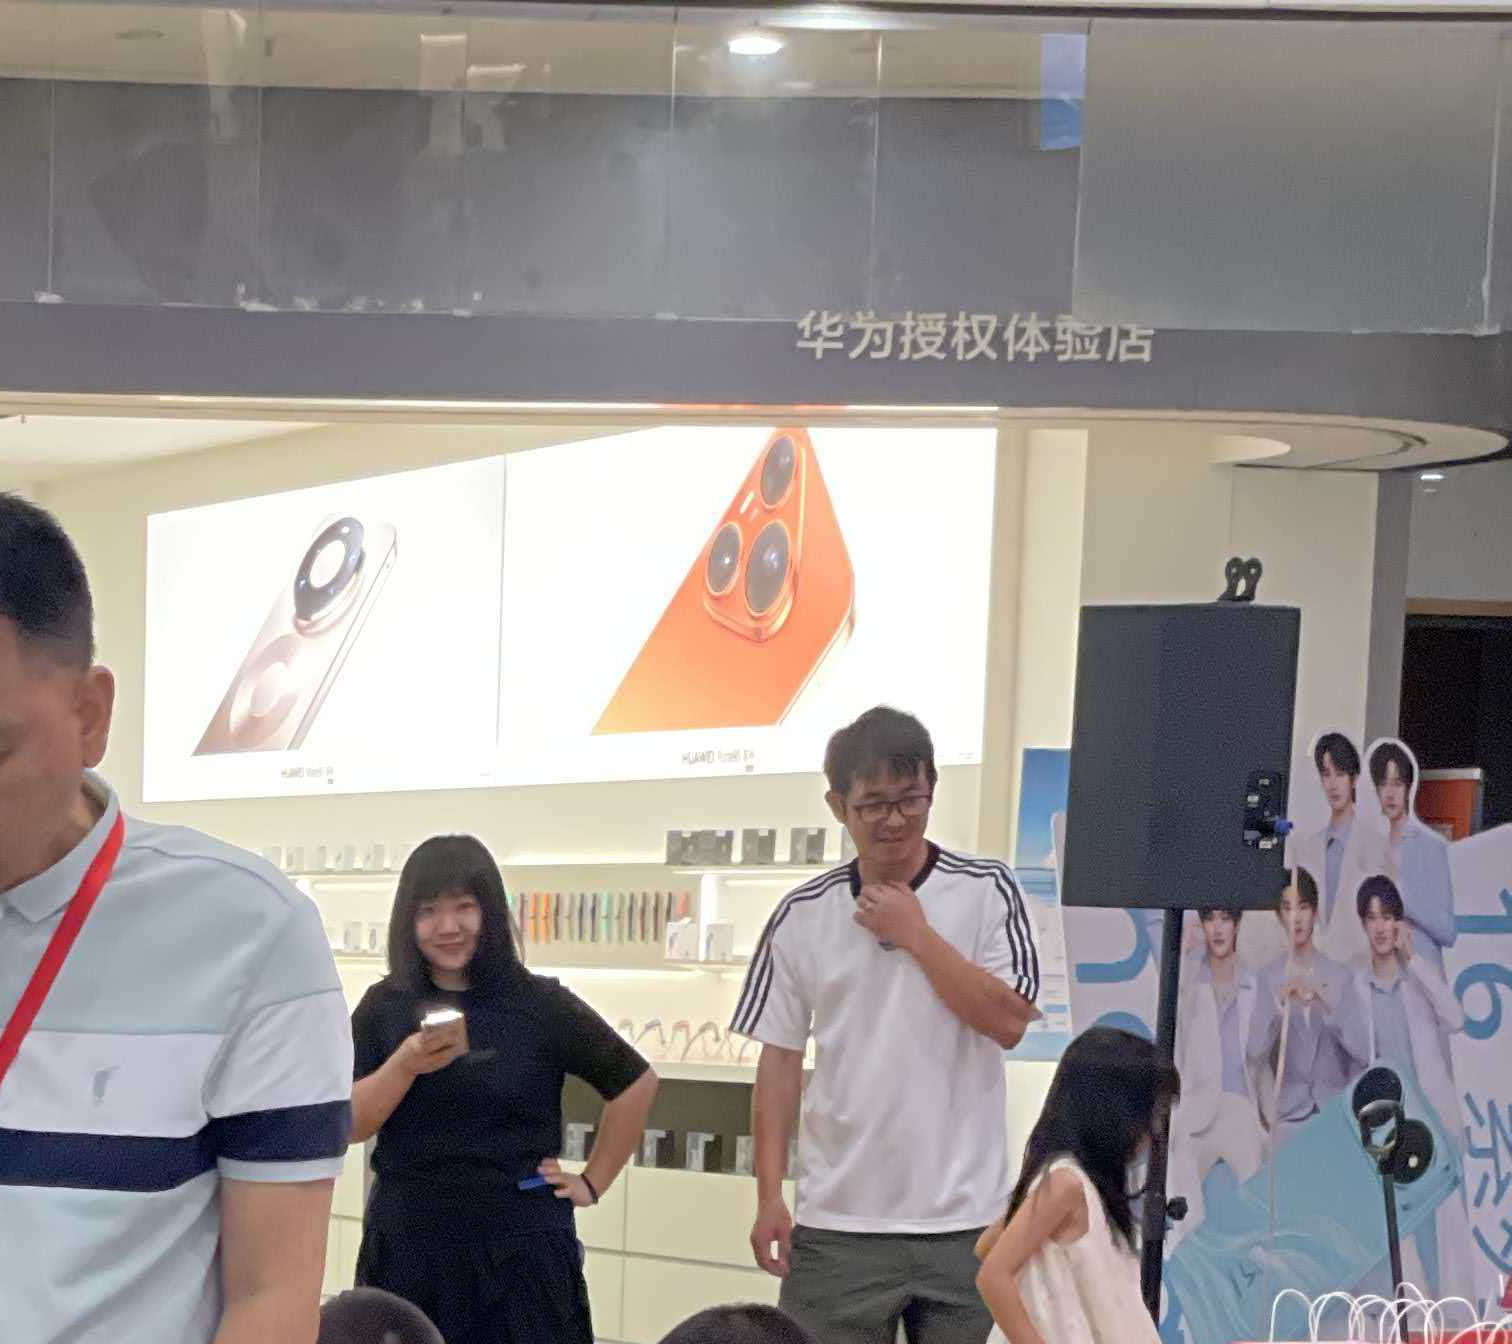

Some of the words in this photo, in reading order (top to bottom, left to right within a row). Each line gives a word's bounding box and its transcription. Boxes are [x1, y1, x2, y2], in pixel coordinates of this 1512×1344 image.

[796, 310, 1155, 362] 华为授权体验店
